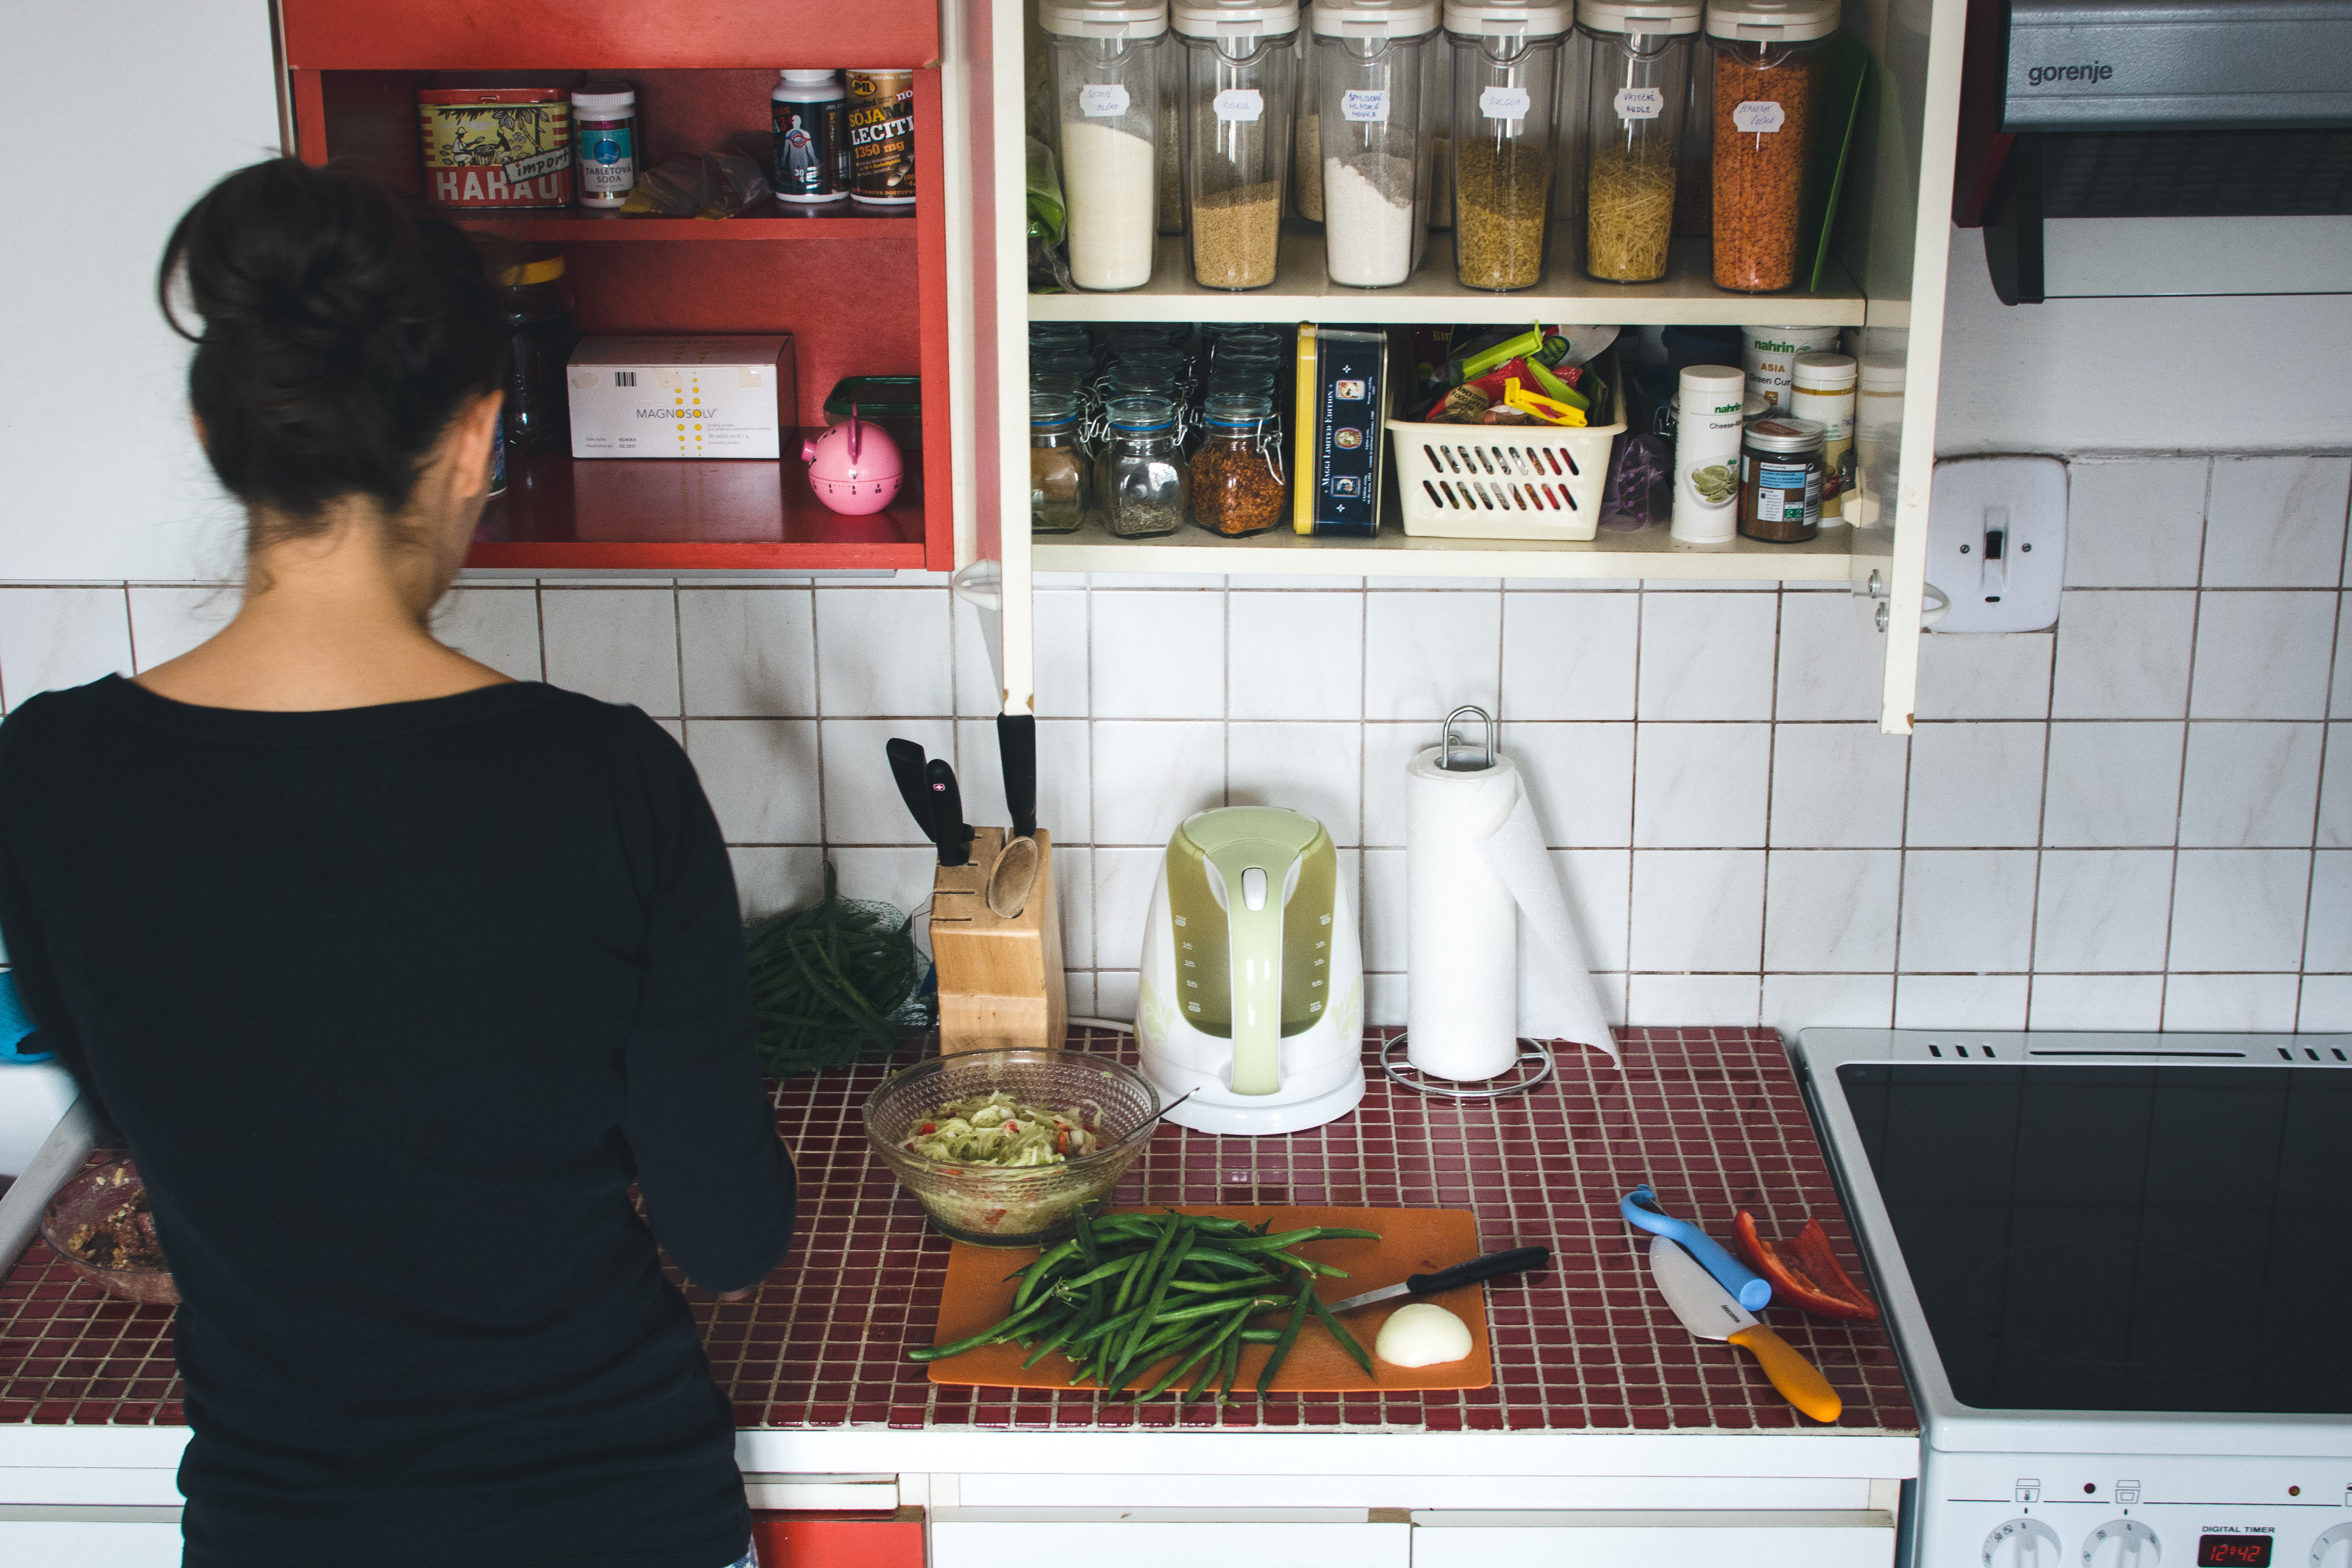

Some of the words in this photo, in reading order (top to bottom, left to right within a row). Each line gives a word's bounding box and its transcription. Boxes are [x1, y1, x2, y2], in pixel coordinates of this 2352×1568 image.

[2028, 60, 2113, 86] gorenje
[1626, 105, 1651, 113] NUDLE
[855, 143, 880, 159] 1350
[883, 141, 904, 153] mg
[514, 149, 568, 177] import
[1754, 340, 1795, 353] nahrin
[1761, 363, 1786, 373] ASIA
[1749, 372, 1772, 385] Green
[1324, 391, 1334, 423] EDITION
[1323, 426, 1332, 459] LIMITED
[1321, 461, 1331, 486] MAGGI
[2210, 1545, 2261, 1562] 12:42
